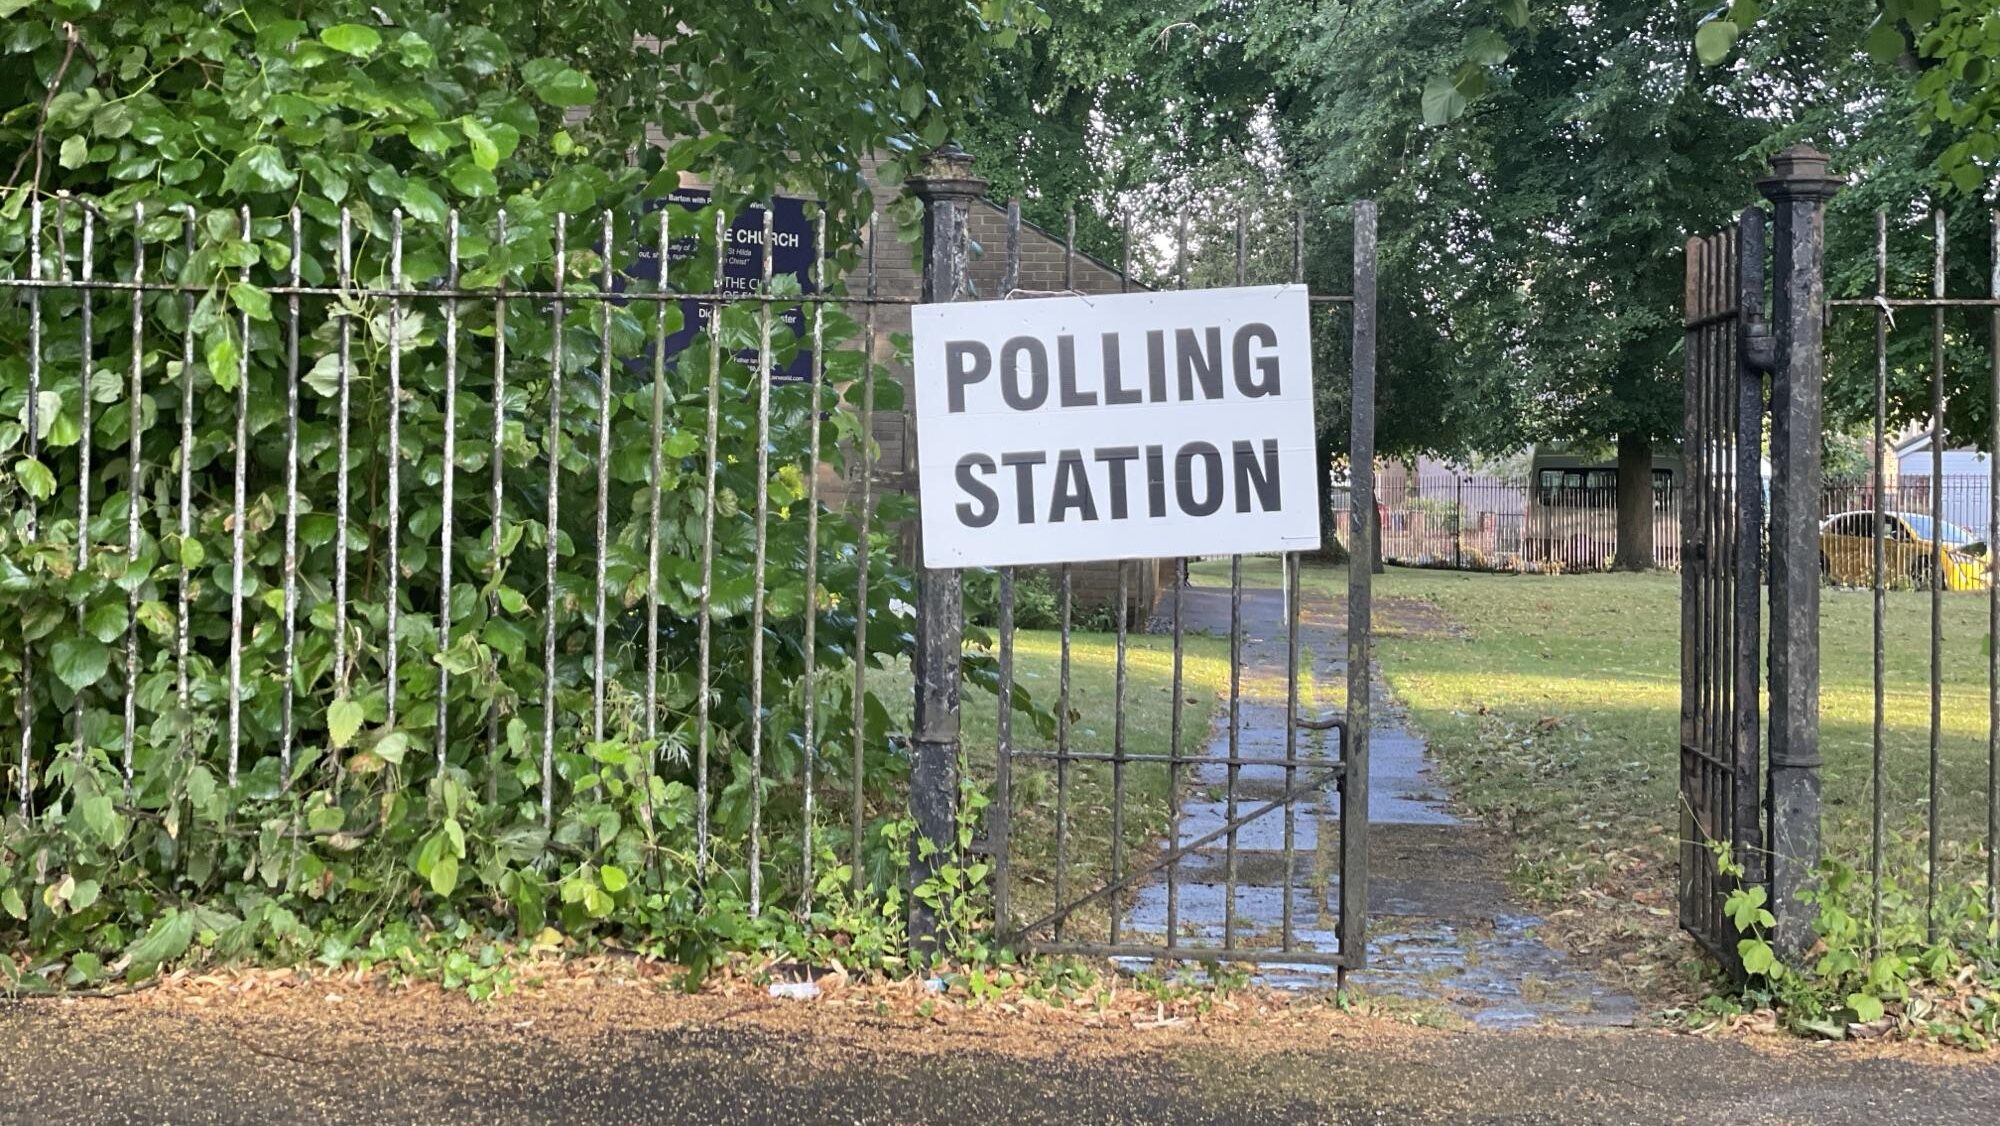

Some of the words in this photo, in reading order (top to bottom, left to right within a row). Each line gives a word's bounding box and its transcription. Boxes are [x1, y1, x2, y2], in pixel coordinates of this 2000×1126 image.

[736, 229, 799, 248] CHURCH
[725, 276, 746, 289] THE
[945, 322, 1281, 413] POLLING
[954, 438, 1281, 528] STATION
